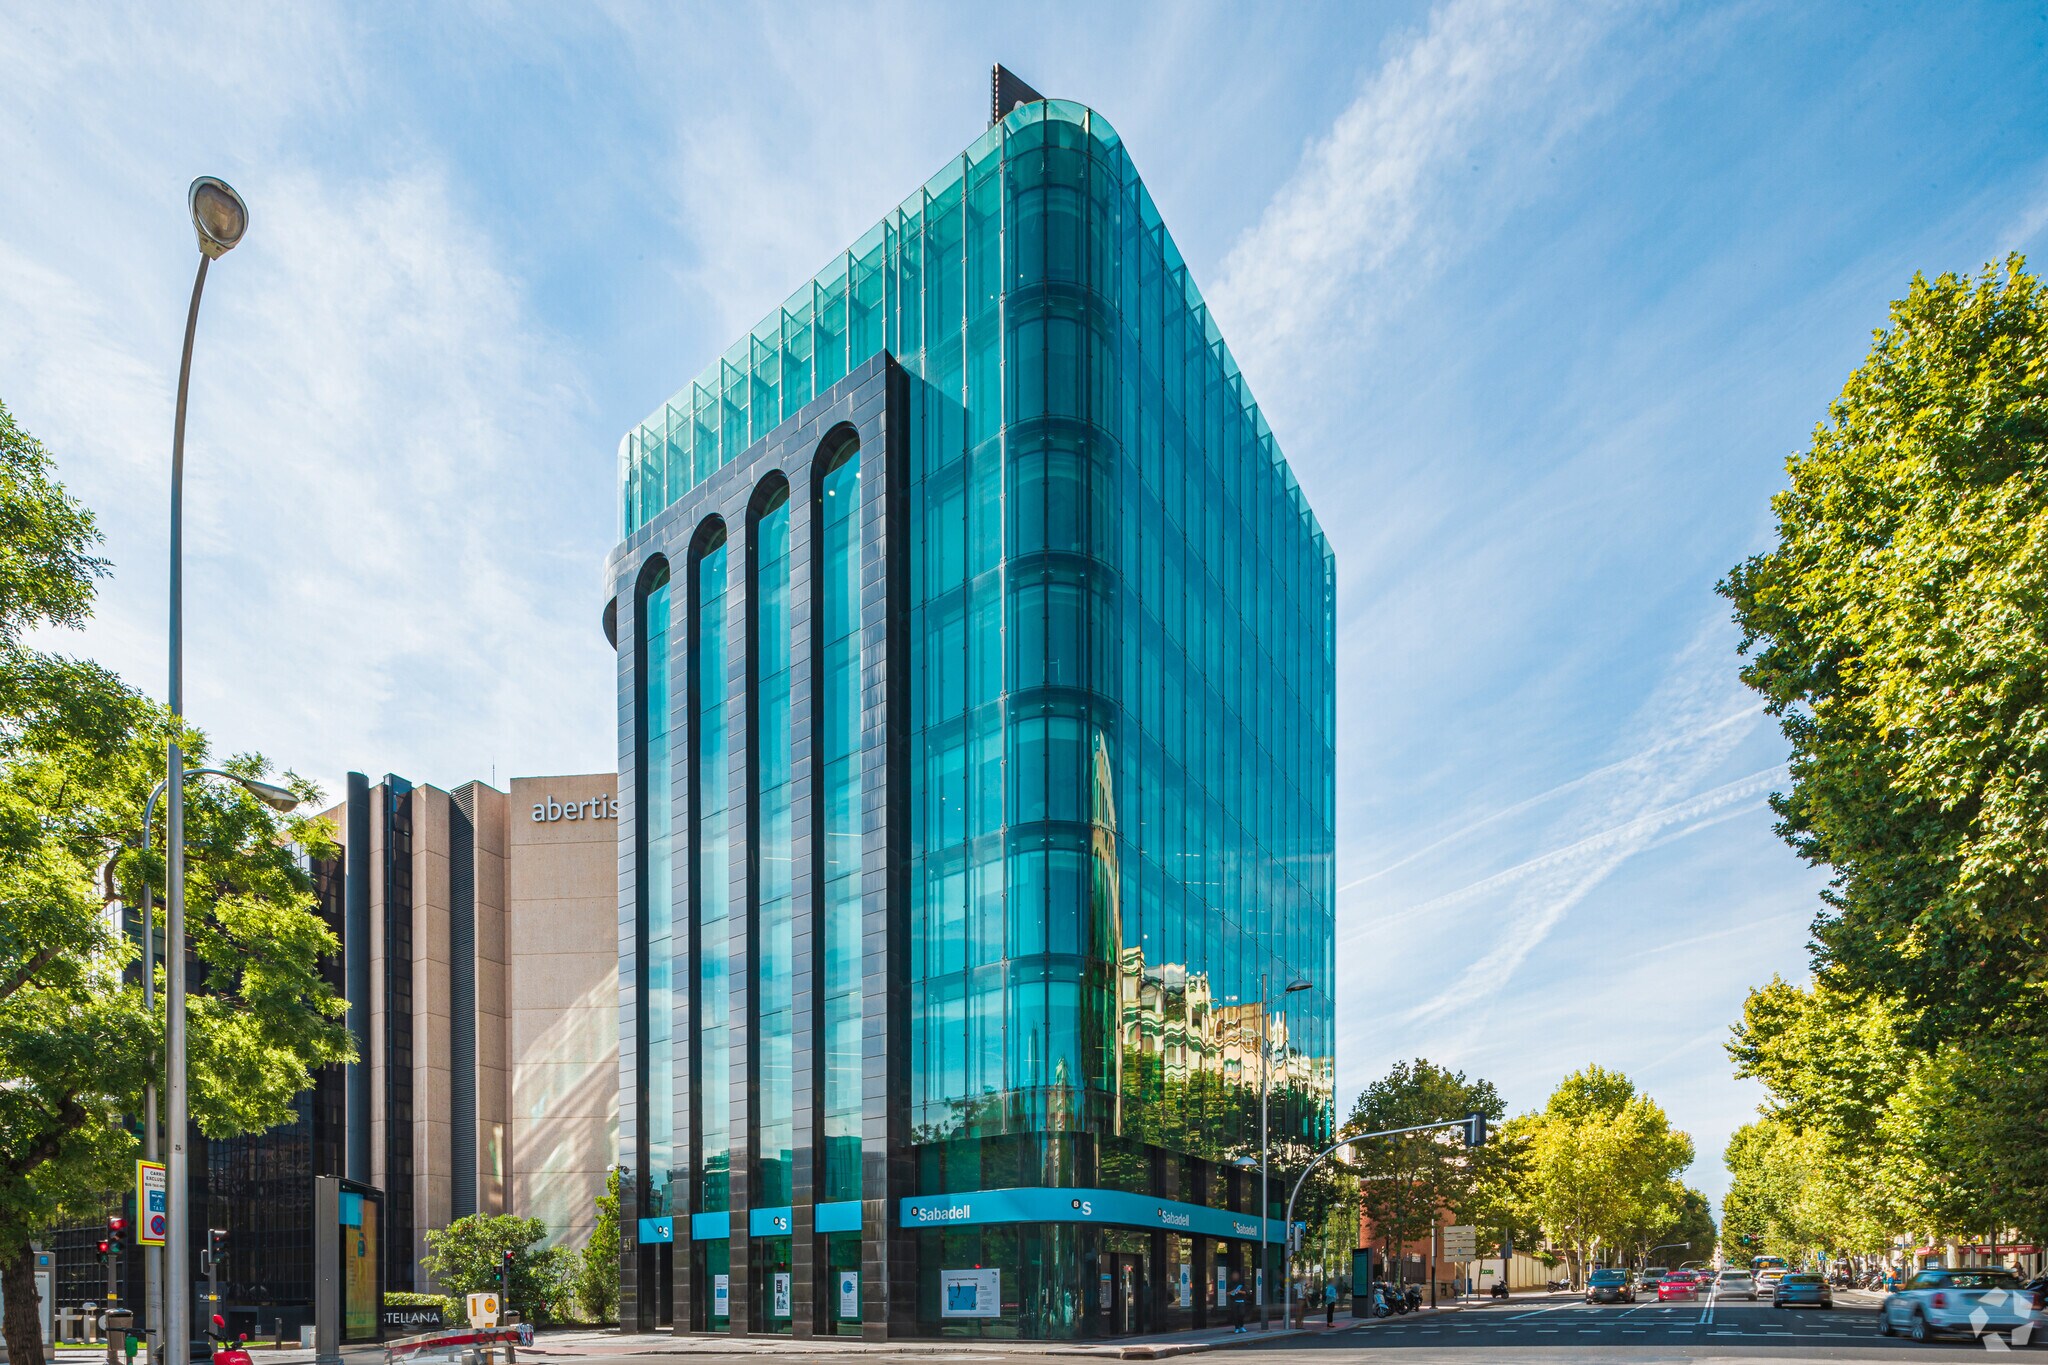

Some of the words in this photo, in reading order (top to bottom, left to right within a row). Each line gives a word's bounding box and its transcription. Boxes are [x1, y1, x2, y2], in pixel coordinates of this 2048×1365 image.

[531, 793, 618, 822] abertis
[919, 1204, 970, 1222] Sabadell
[1081, 1201, 1092, 1216] S
[1162, 1210, 1190, 1227] Sabadell
[1236, 1222, 1257, 1236] Sabadell
[384, 1312, 440, 1324] TELLANA
